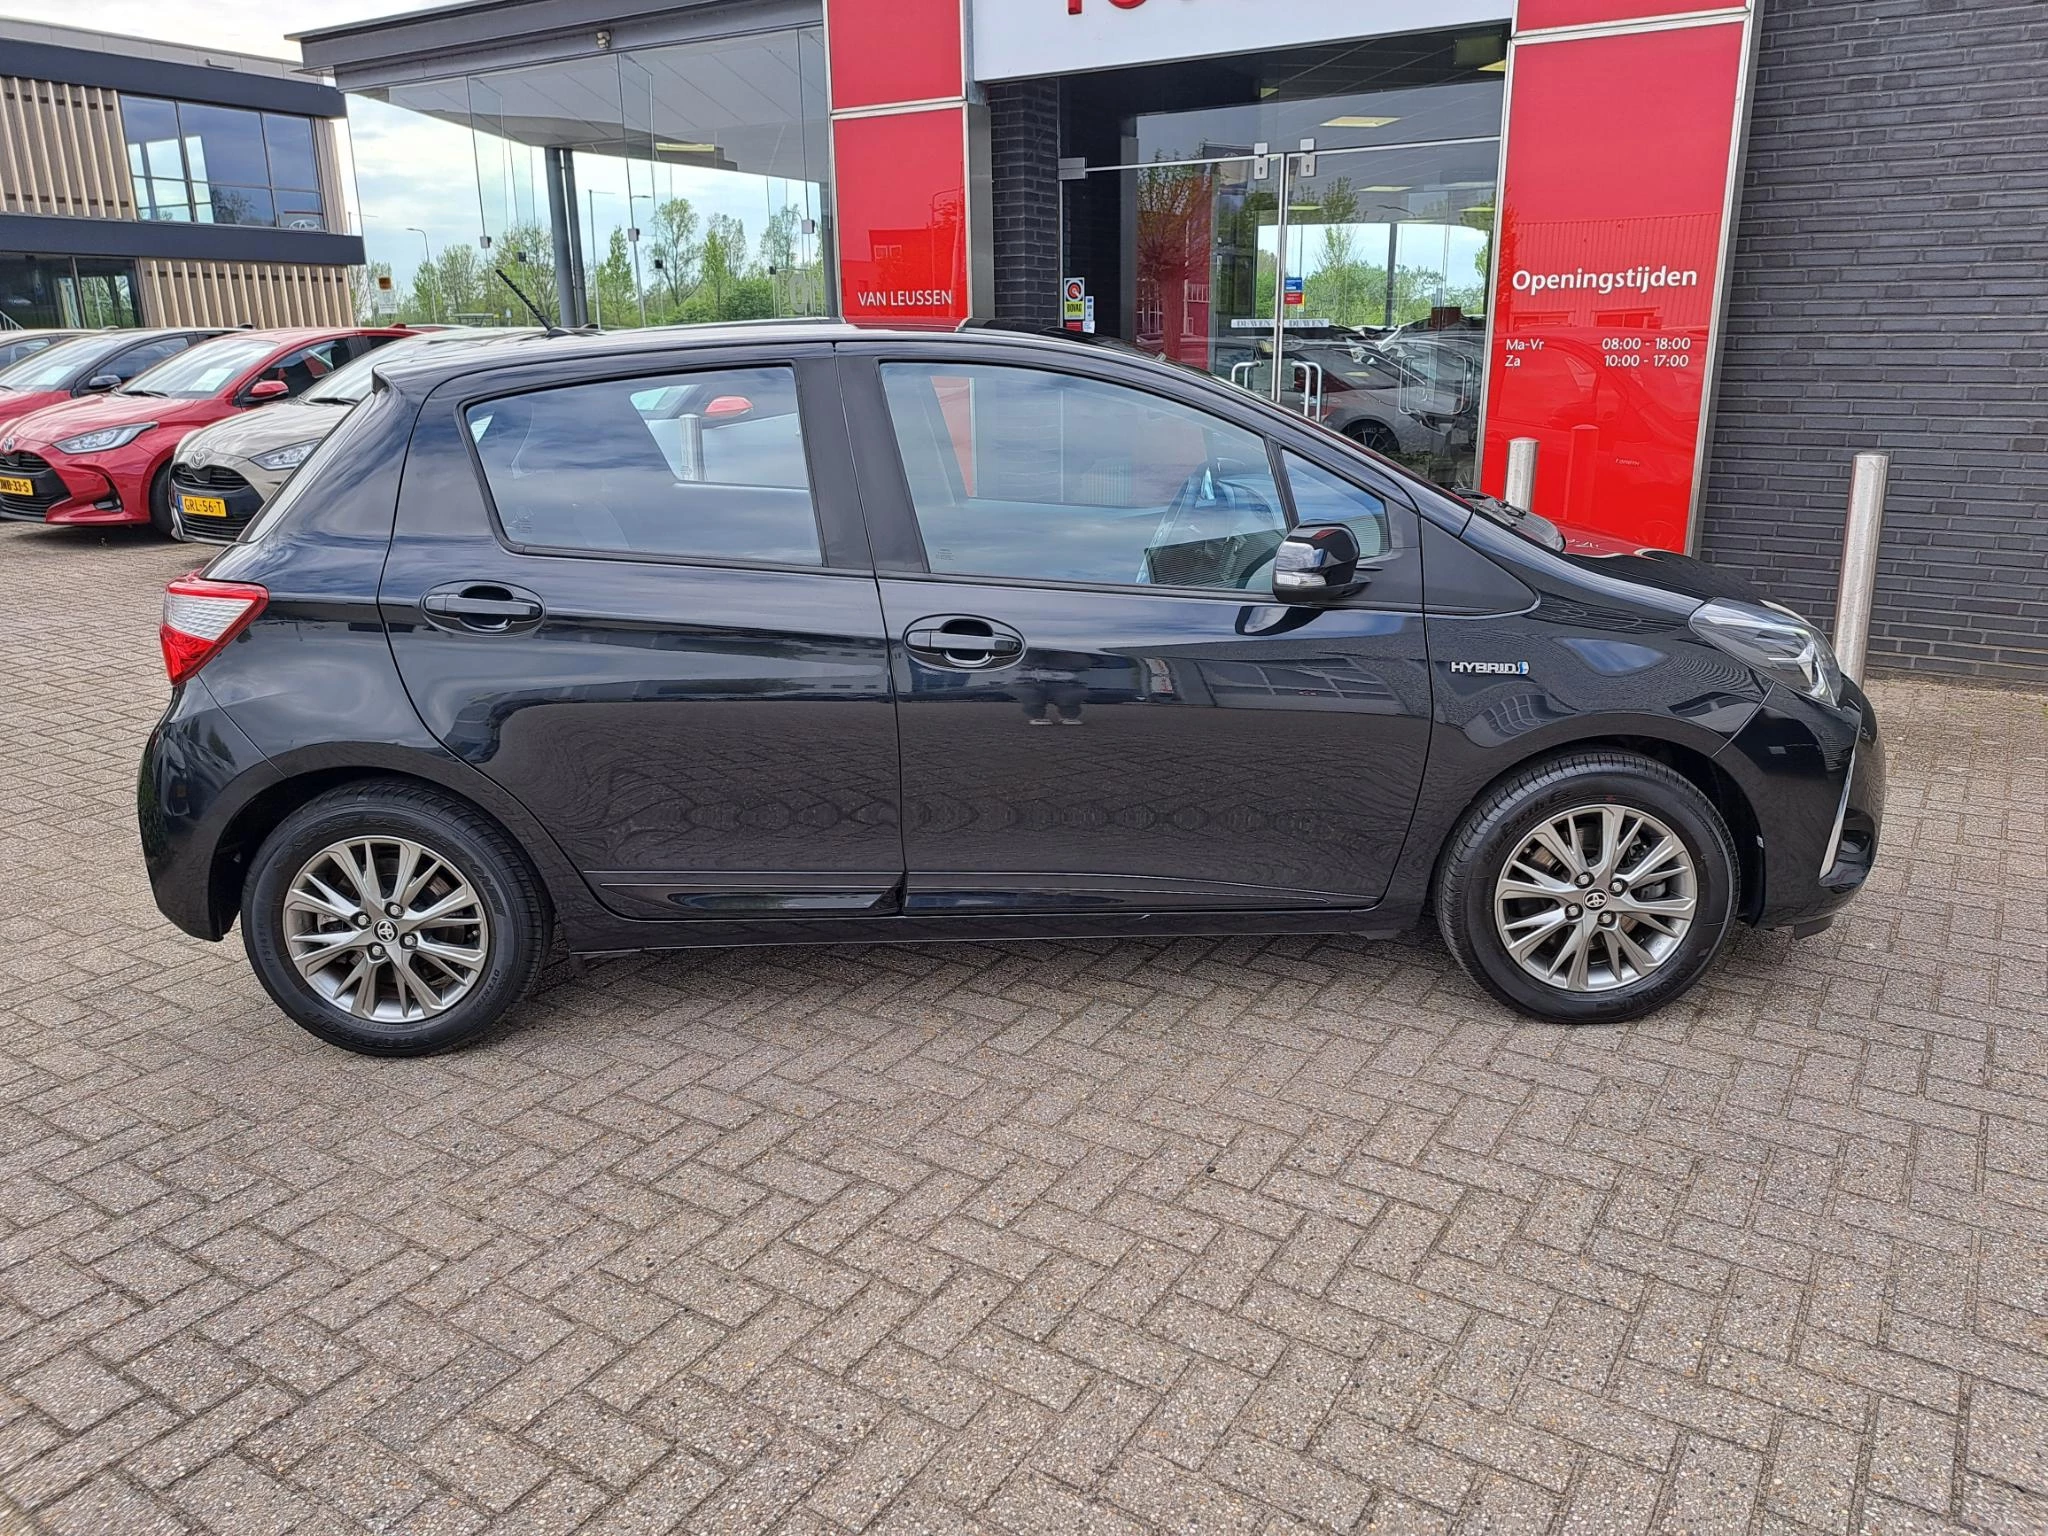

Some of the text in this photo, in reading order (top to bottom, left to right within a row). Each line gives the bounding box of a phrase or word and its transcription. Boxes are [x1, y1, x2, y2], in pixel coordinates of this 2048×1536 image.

[1512, 265, 1697, 295] Openingstijden
[857, 289, 953, 307] VAN LEUSSEN
[1505, 337, 1545, 351] Ma-Vr
[1601, 337, 1642, 350] 08:00
[1655, 337, 1691, 350] 18:00
[1504, 355, 1521, 367] Za
[1604, 354, 1640, 367] 10:00
[1653, 354, 1689, 367] 17:00
[184, 498, 222, 514] GRL-56-T
[1450, 661, 1518, 675] HYBRID
